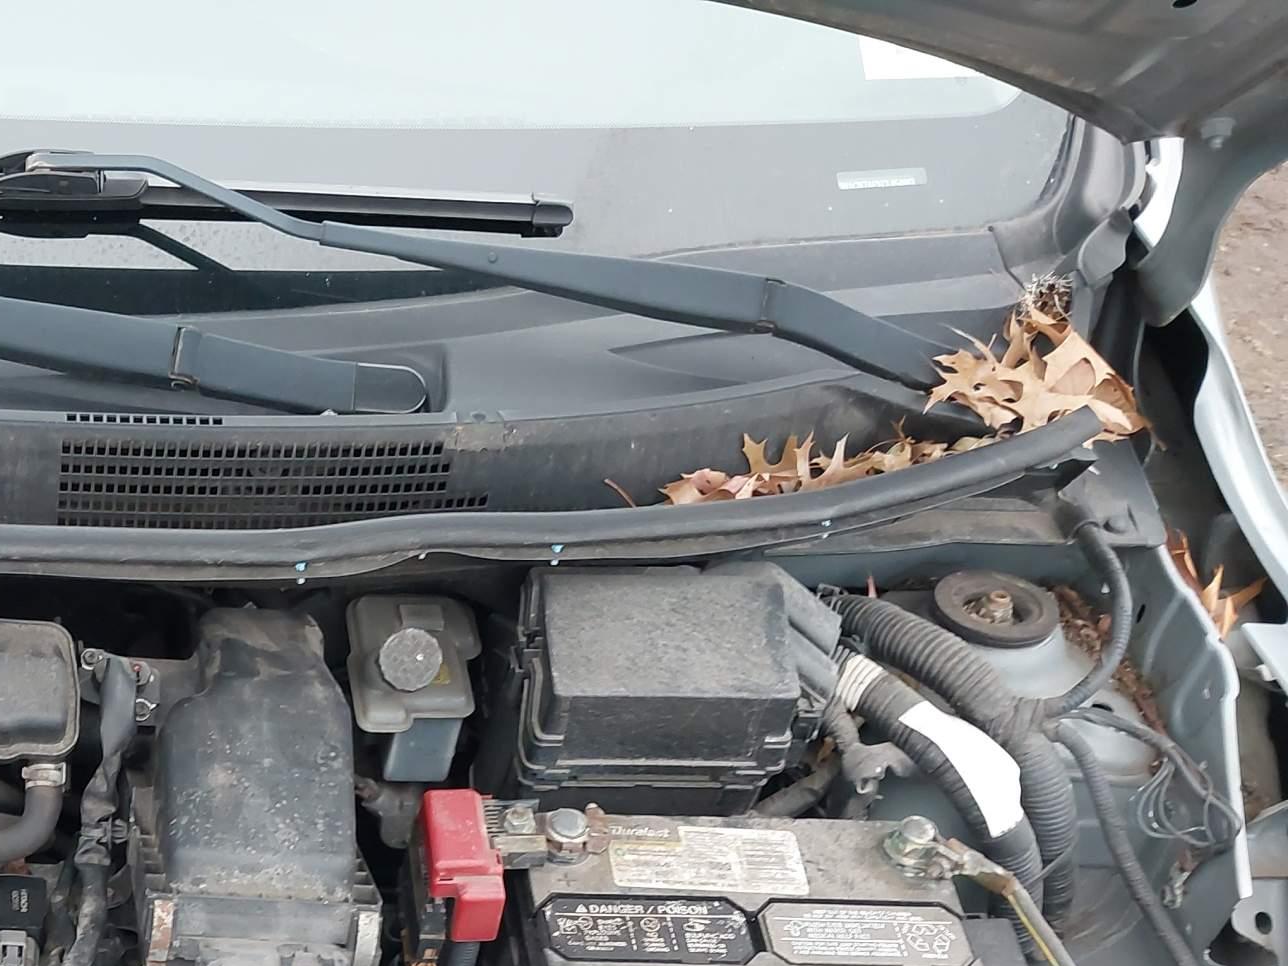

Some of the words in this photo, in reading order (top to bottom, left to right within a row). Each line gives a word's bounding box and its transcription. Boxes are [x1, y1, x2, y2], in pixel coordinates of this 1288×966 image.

[607, 826, 671, 838] Duralast
[589, 905, 645, 914] DANGER
[658, 905, 708, 915] POISON
